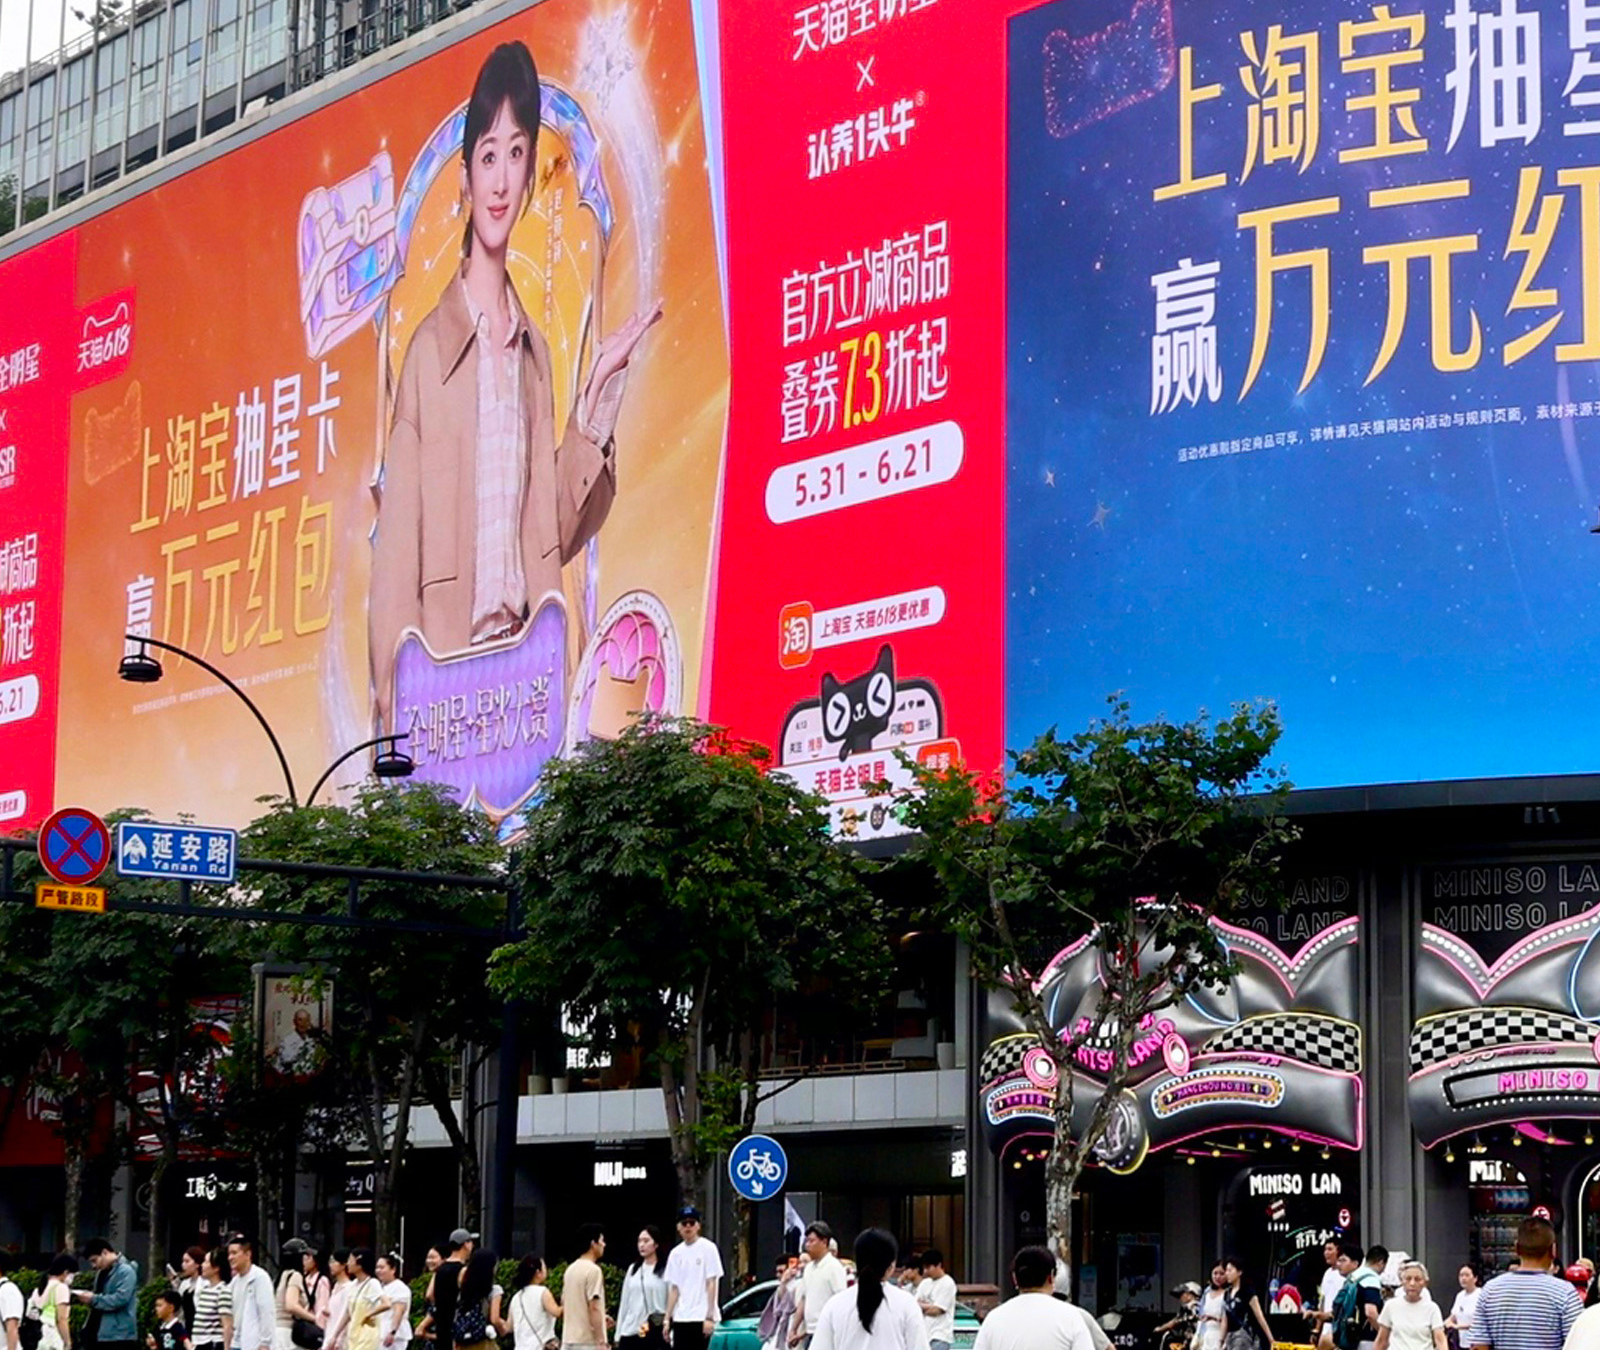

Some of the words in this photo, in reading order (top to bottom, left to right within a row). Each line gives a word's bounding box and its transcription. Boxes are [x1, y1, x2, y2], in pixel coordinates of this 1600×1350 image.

[782, 220, 949, 348] 官方立减商品
[781, 316, 949, 444] 叠券7.3折起
[130, 360, 341, 534] 上淘宝抽星卡
[784, 615, 809, 655] 淘
[152, 833, 228, 863] 延安路
[209, 864, 226, 874] Rd
[1434, 866, 1547, 897] MINISO
[41, 890, 98, 907] 严管路段
[1434, 903, 1547, 932] MINISO
[1500, 1070, 1588, 1093] MINISO
[1250, 1174, 1302, 1196] MINISO
